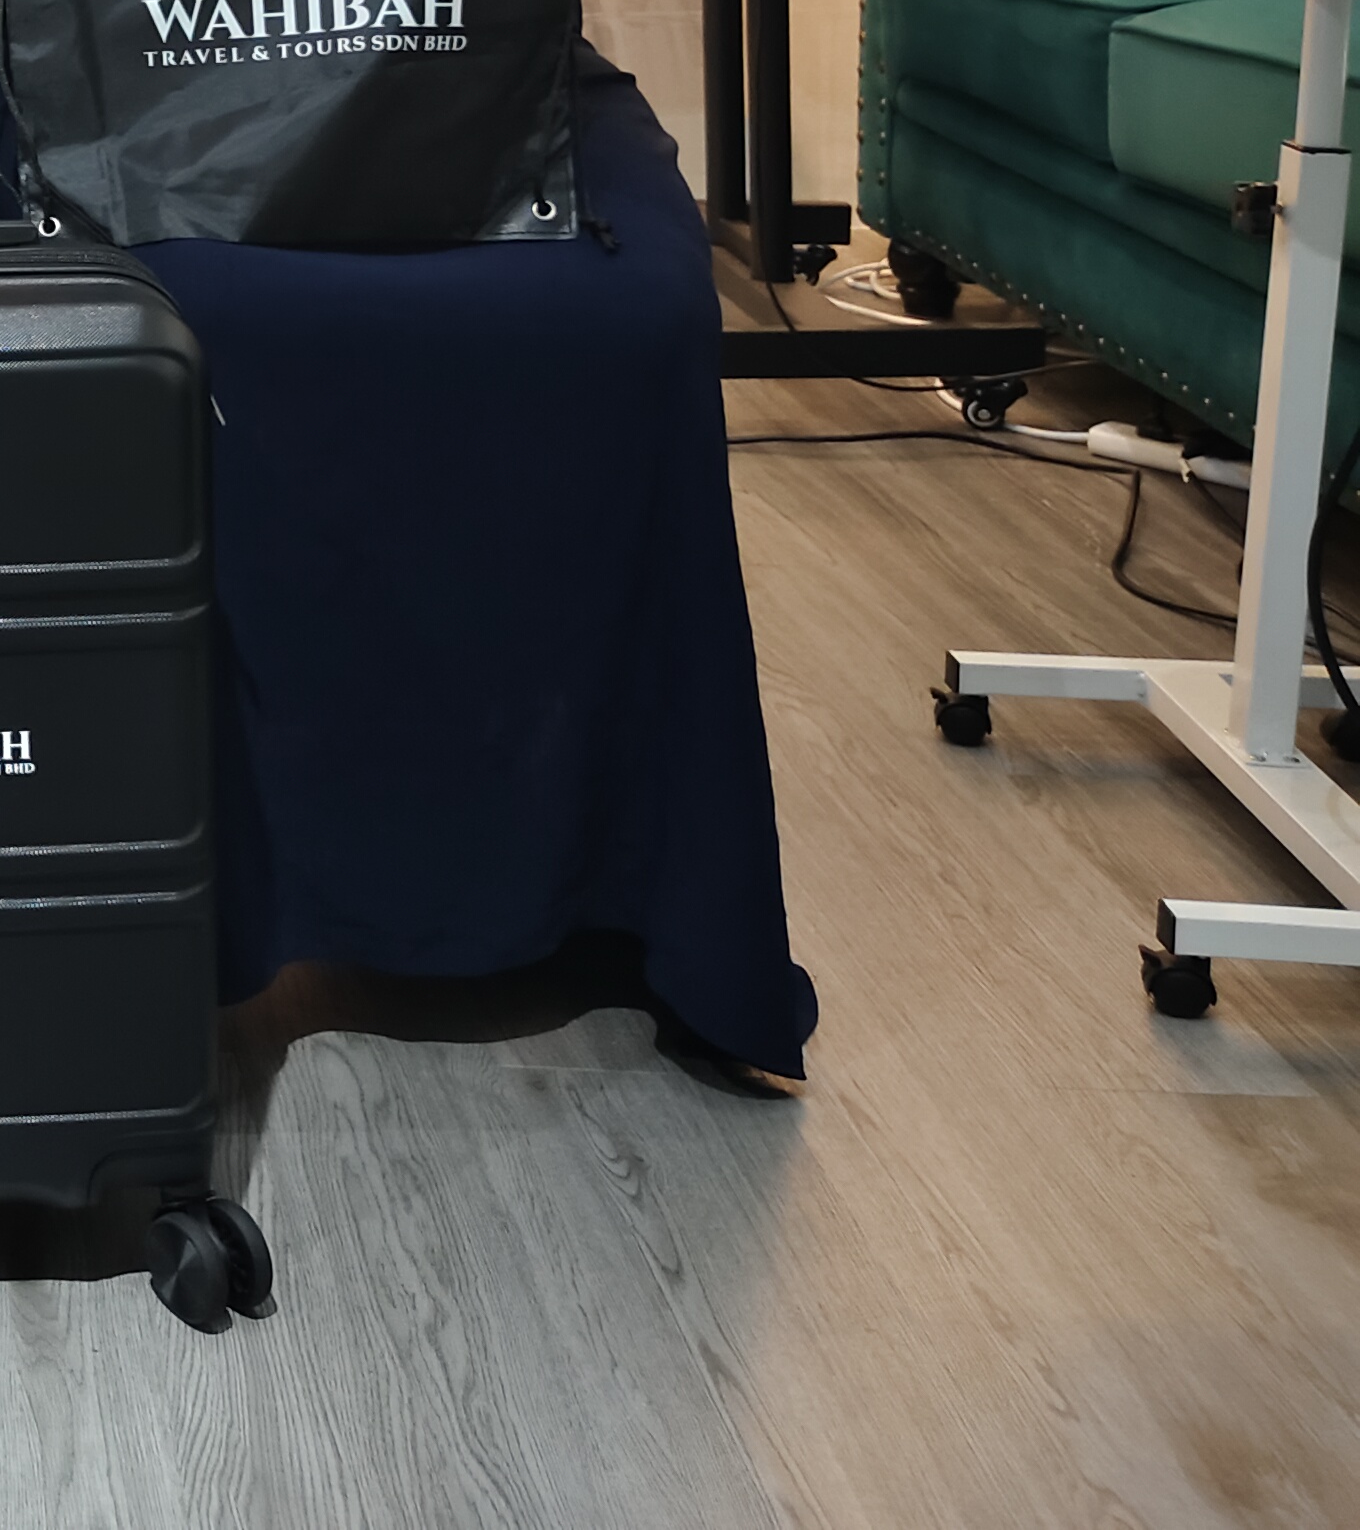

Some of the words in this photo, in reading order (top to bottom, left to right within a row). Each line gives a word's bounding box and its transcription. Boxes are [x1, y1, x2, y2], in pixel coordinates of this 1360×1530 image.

[143, 46, 245, 68] TRAVEL
[251, 45, 270, 62] &
[277, 35, 366, 60] TOURS
[371, 34, 419, 52] SDN
[423, 34, 467, 52] BHD
[5, 762, 36, 775] BHD
